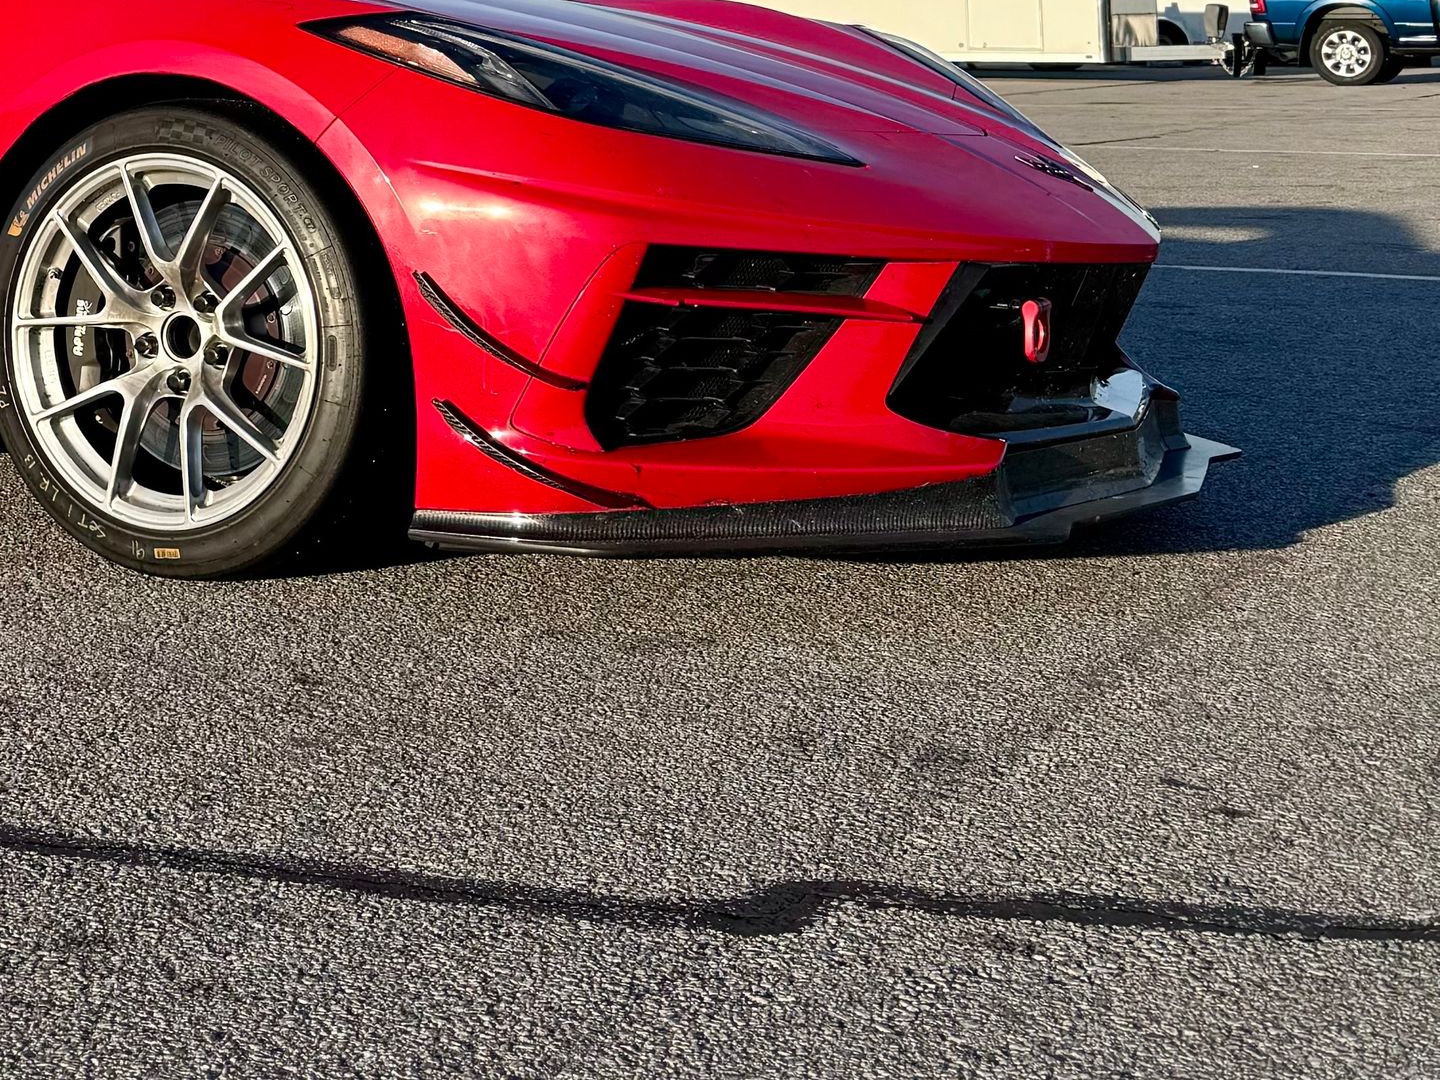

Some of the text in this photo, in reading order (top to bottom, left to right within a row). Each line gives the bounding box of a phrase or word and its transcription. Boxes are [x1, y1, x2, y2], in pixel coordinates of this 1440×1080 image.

[26, 142, 88, 210] MICHELIN
[215, 133, 263, 168] PILOT
[260, 166, 308, 218] SPORT
